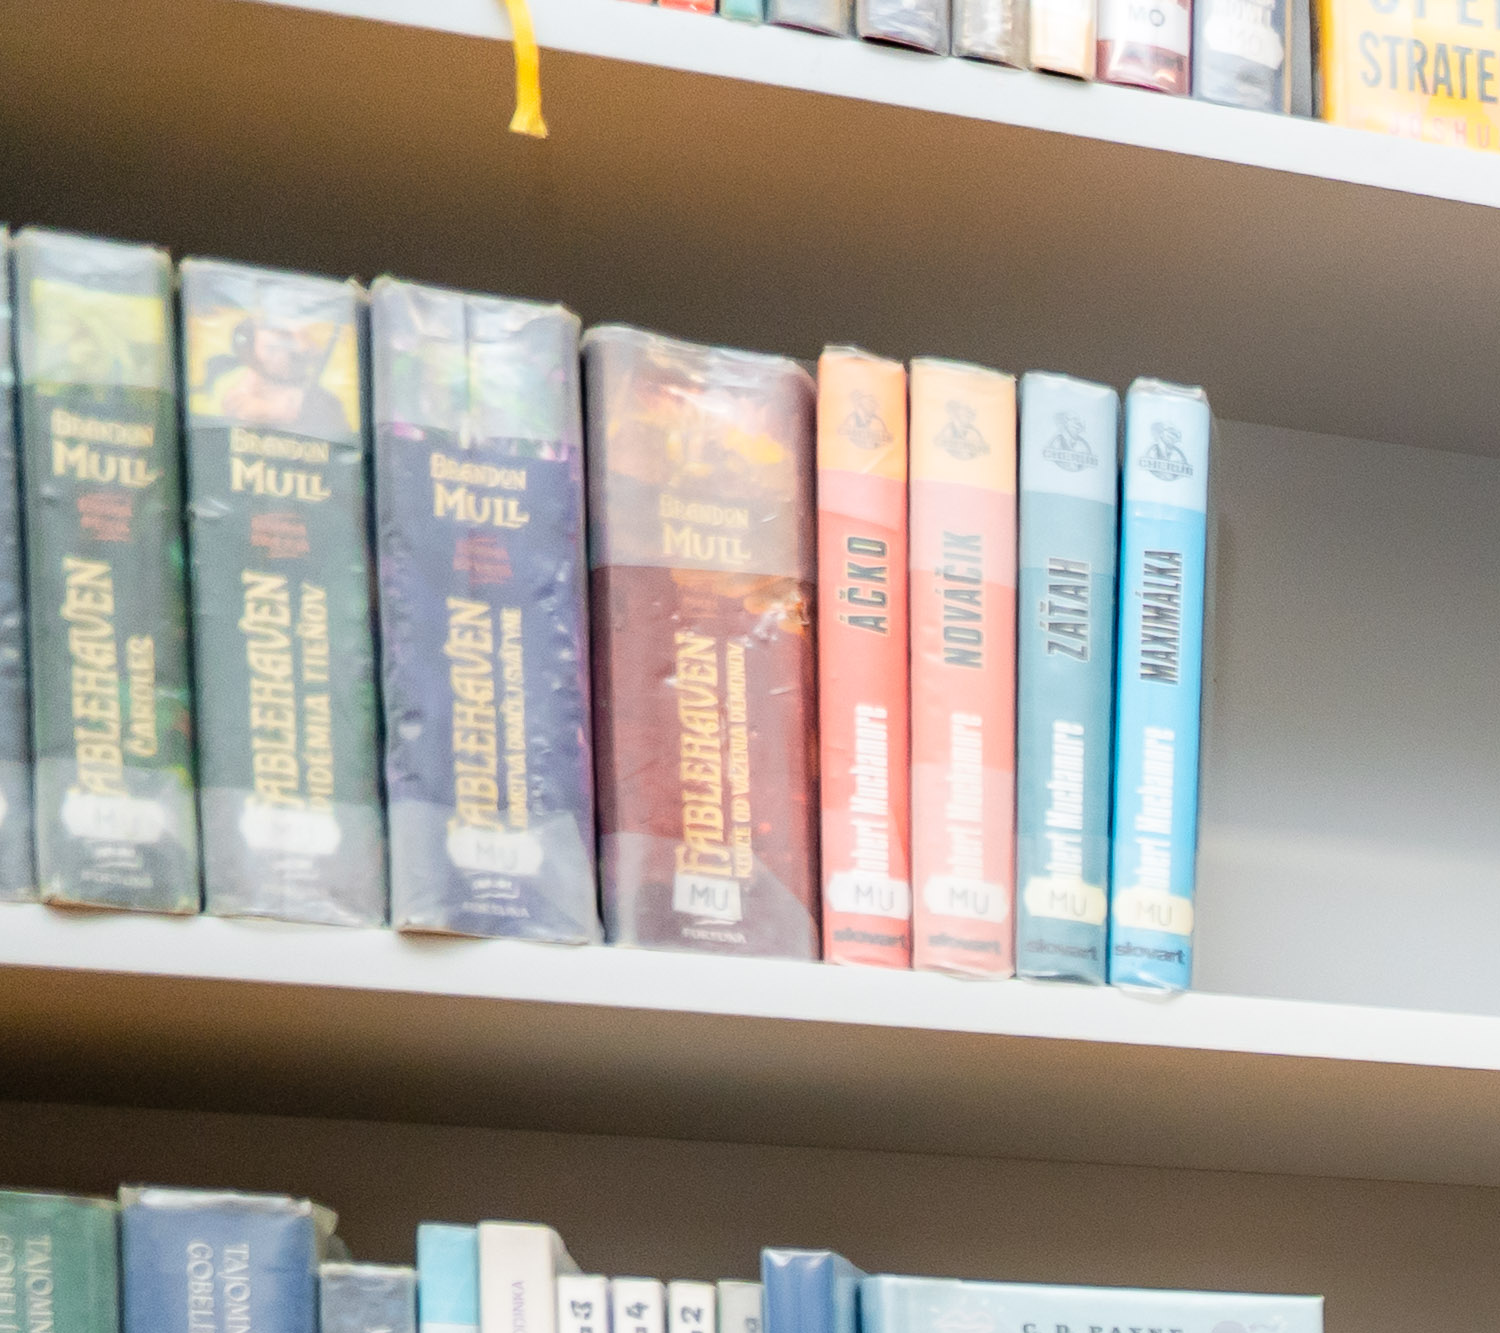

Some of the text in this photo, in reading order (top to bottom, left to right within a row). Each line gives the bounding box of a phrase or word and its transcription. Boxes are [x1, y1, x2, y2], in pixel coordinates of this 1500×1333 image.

[52, 439, 161, 489] MULL
[433, 488, 530, 529] MULL
[842, 535, 889, 634] ÁČKO
[941, 529, 982, 669] NOVÁČIK
[1046, 557, 1091, 662] ZÁŤAH
[1139, 548, 1181, 685] MAXIMÁLKA
